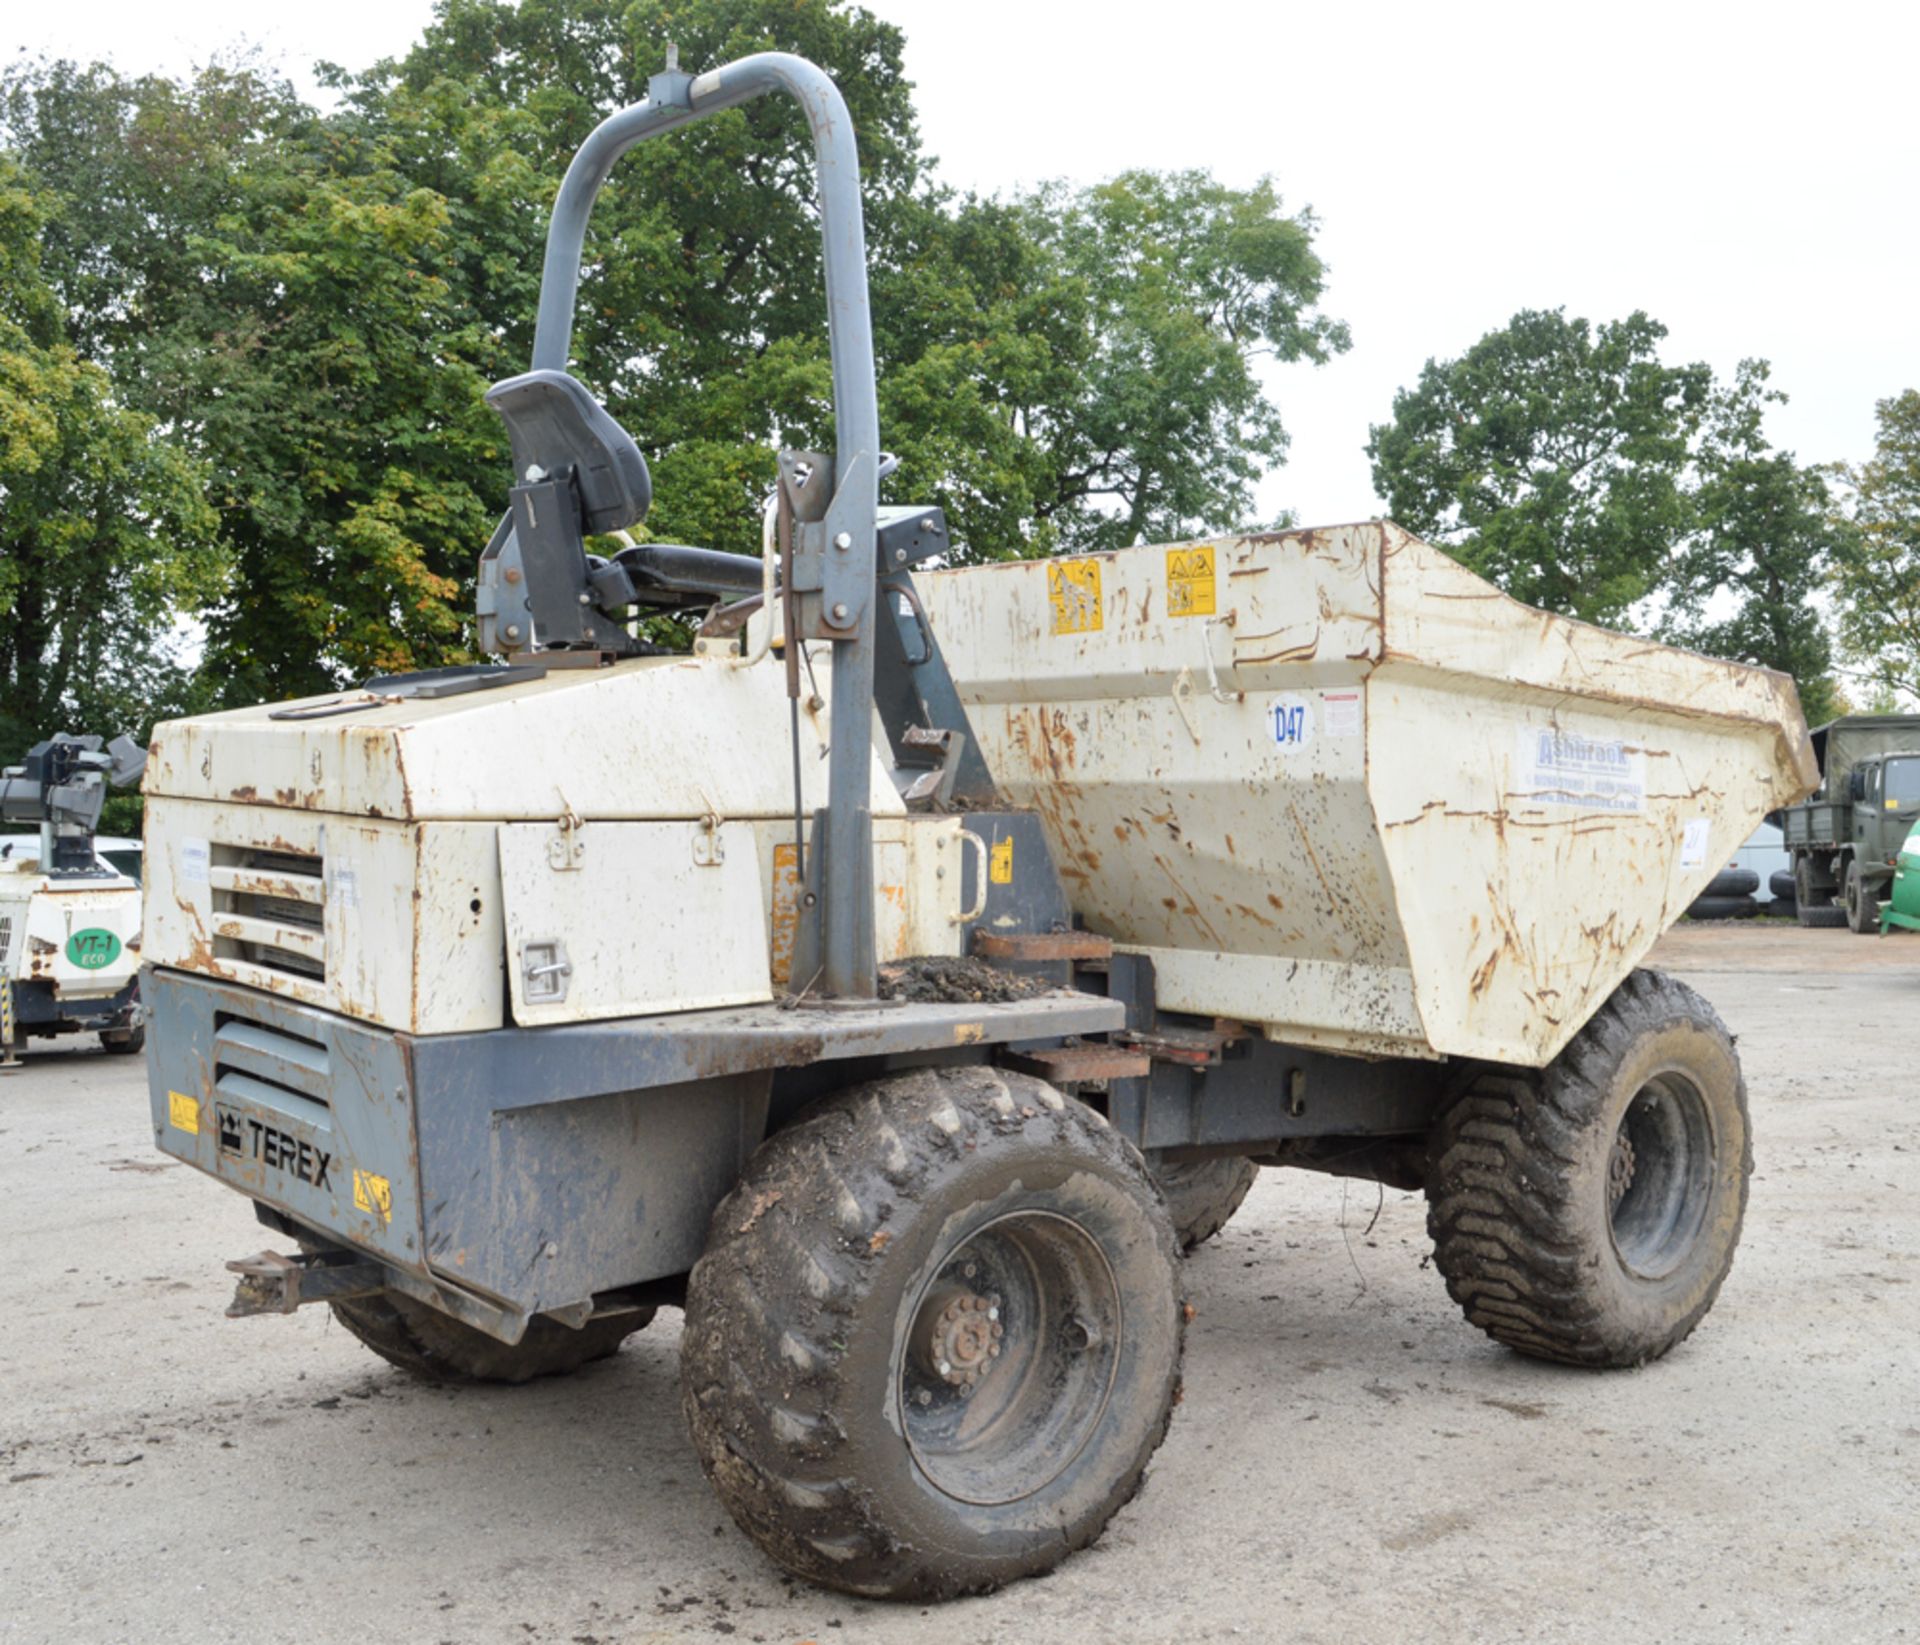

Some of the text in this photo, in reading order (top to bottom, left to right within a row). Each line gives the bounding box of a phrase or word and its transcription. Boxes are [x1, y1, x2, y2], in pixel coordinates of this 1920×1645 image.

[1275, 705, 1304, 743] D47
[1539, 734, 1627, 765] Ashbrook
[74, 934, 113, 953] VT-1
[81, 953, 106, 966] ECO
[248, 1118, 333, 1193] TEREX
